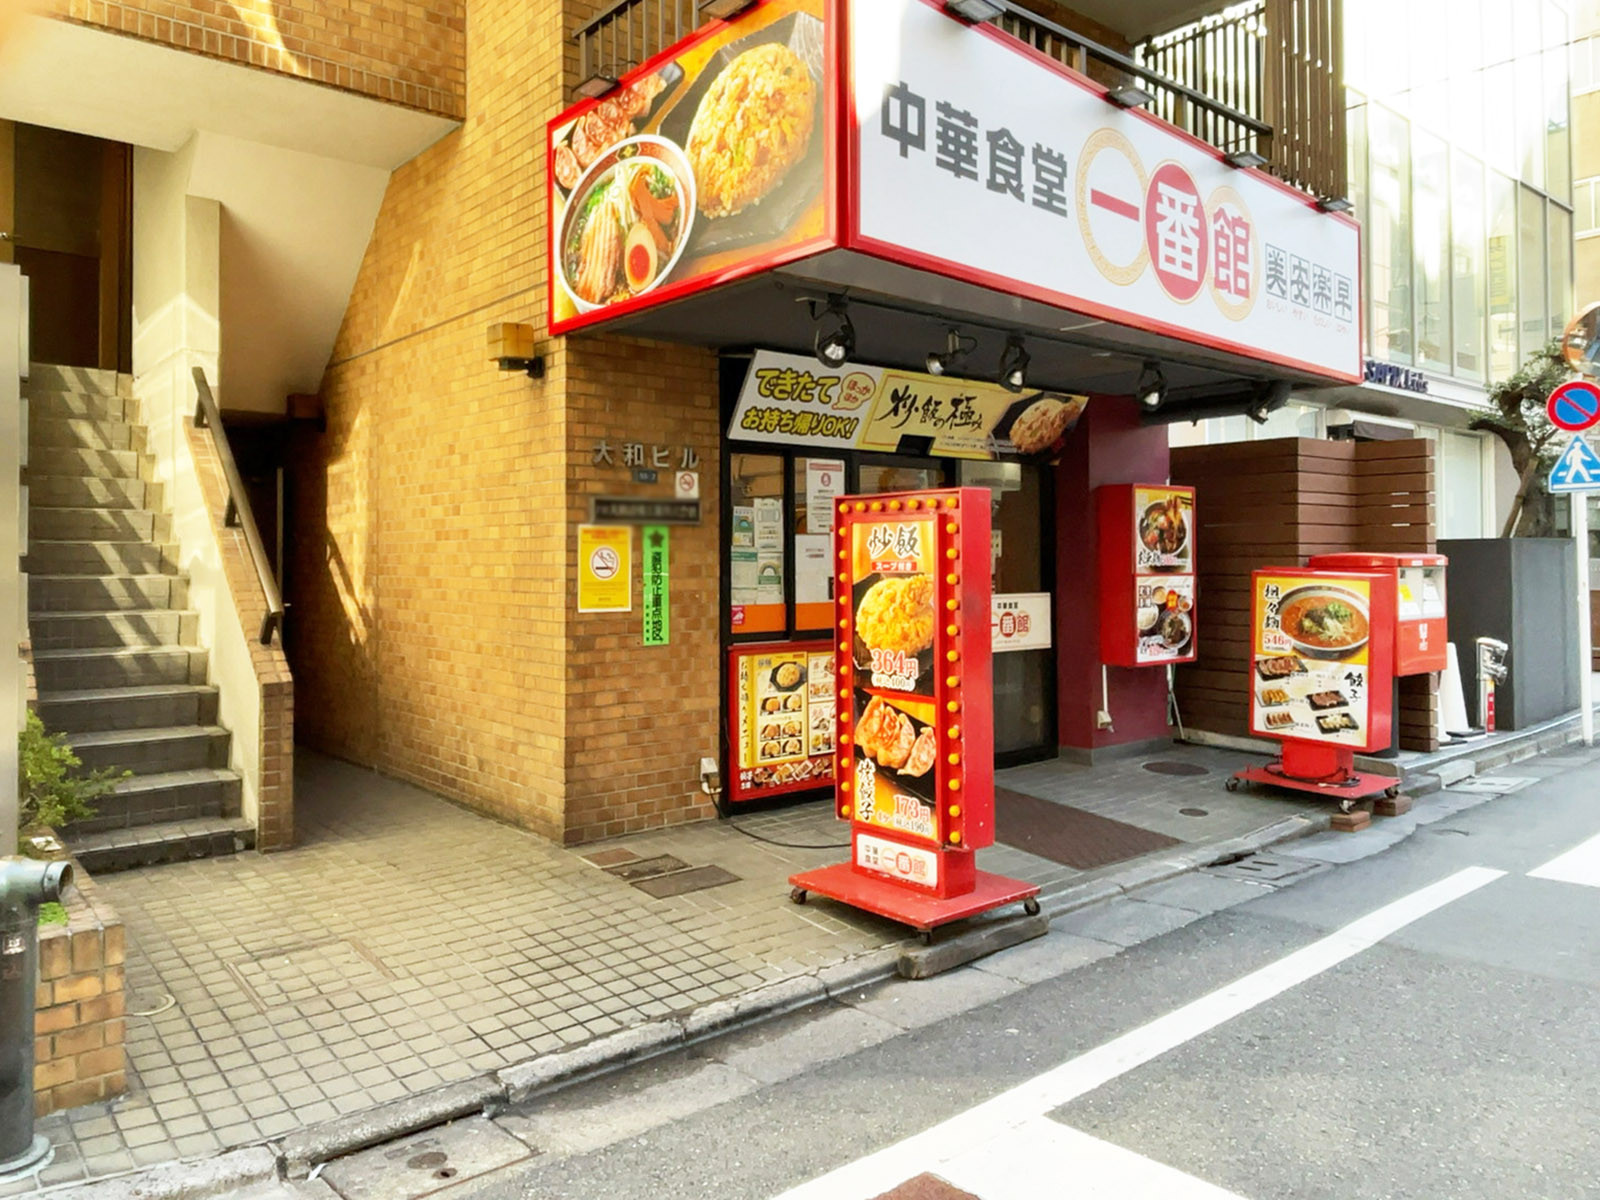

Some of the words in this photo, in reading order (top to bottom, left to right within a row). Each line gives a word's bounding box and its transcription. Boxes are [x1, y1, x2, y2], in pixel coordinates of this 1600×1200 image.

[880, 80, 1068, 218] 中華食堂
[1090, 180, 1250, 300] 一番館
[755, 367, 841, 405] できたて
[874, 384, 983, 433] 炒飯の極み
[868, 525, 921, 557] 炒飯
[871, 648, 918, 679] 364円
[1343, 671, 1364, 703] 餃子
[858, 760, 874, 821] 焼餃子
[894, 795, 931, 824] 173円
